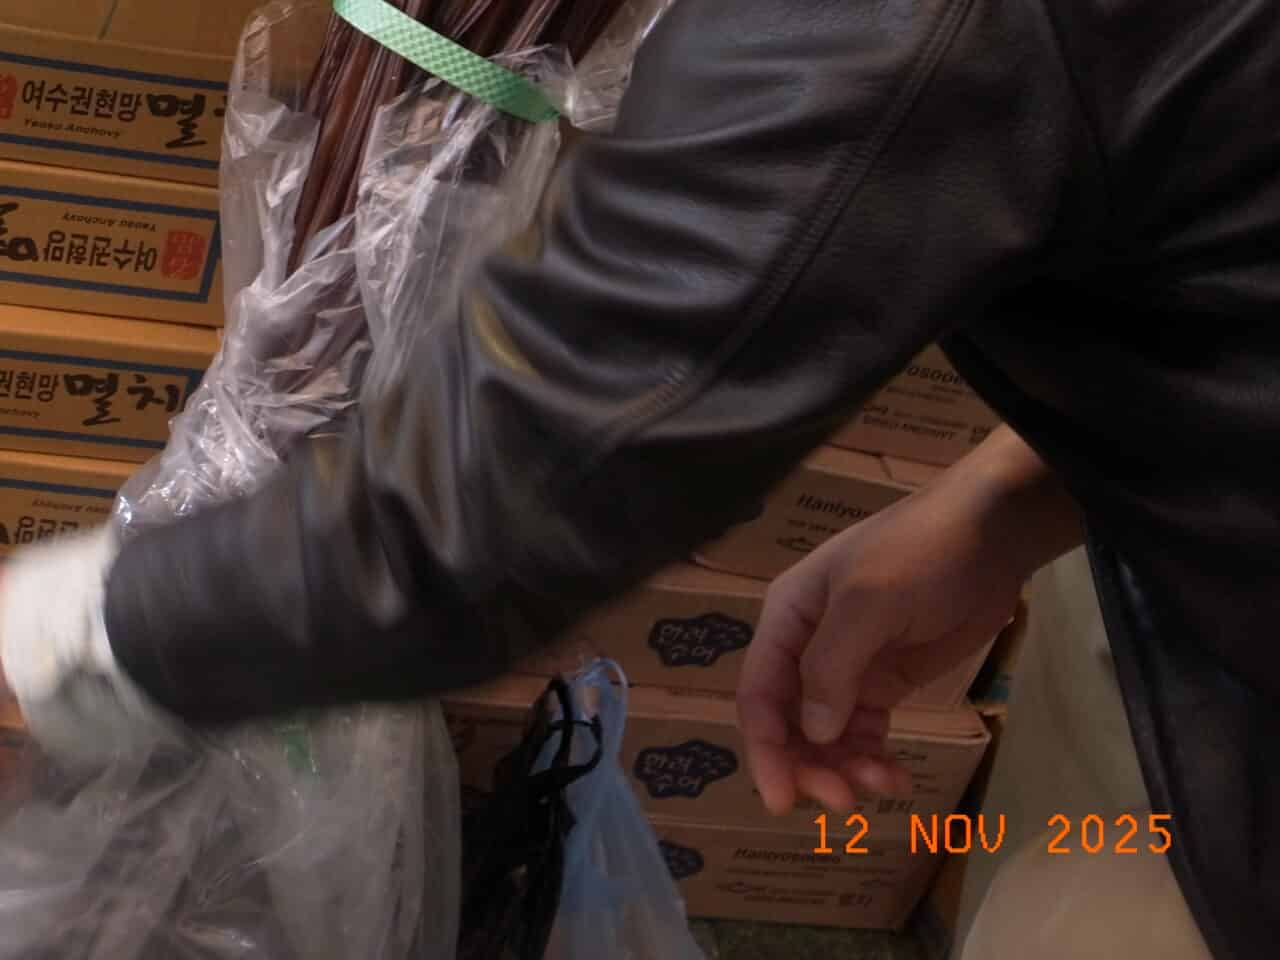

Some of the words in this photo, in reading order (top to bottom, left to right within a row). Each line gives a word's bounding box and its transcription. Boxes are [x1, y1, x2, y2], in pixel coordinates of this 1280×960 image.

[22, 80, 141, 123] 여수권현망
[147, 92, 225, 149] 멸
[65, 124, 121, 138] Anchovy
[62, 212, 116, 227] Anchovy
[43, 229, 158, 272] 여수권현망
[64, 373, 179, 426] 멸치
